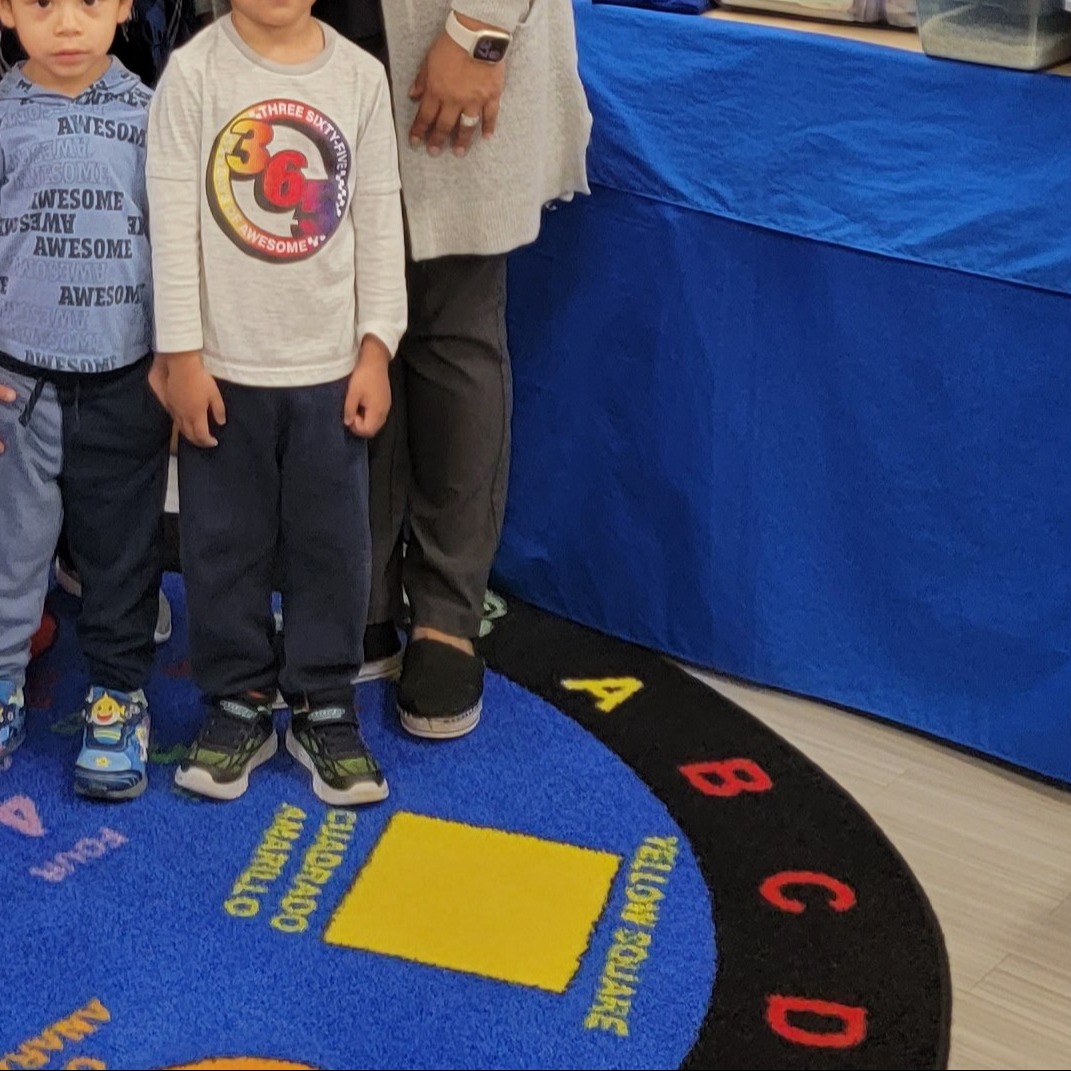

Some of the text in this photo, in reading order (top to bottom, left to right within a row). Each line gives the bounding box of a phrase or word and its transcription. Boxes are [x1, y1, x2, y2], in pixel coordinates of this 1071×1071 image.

[57, 114, 146, 148] AWESOM
[260, 102, 348, 170] THREE SIXTY-FIVE
[33, 236, 133, 260] AWESOME
[240, 224, 309, 254] AWESOME
[560, 676, 645, 713] A
[680, 757, 773, 798] B
[224, 802, 307, 917] AMARILLO
[759, 870, 857, 914] C
[584, 836, 678, 1037] YELLOW SQUARE
[765, 994, 868, 1050] D
